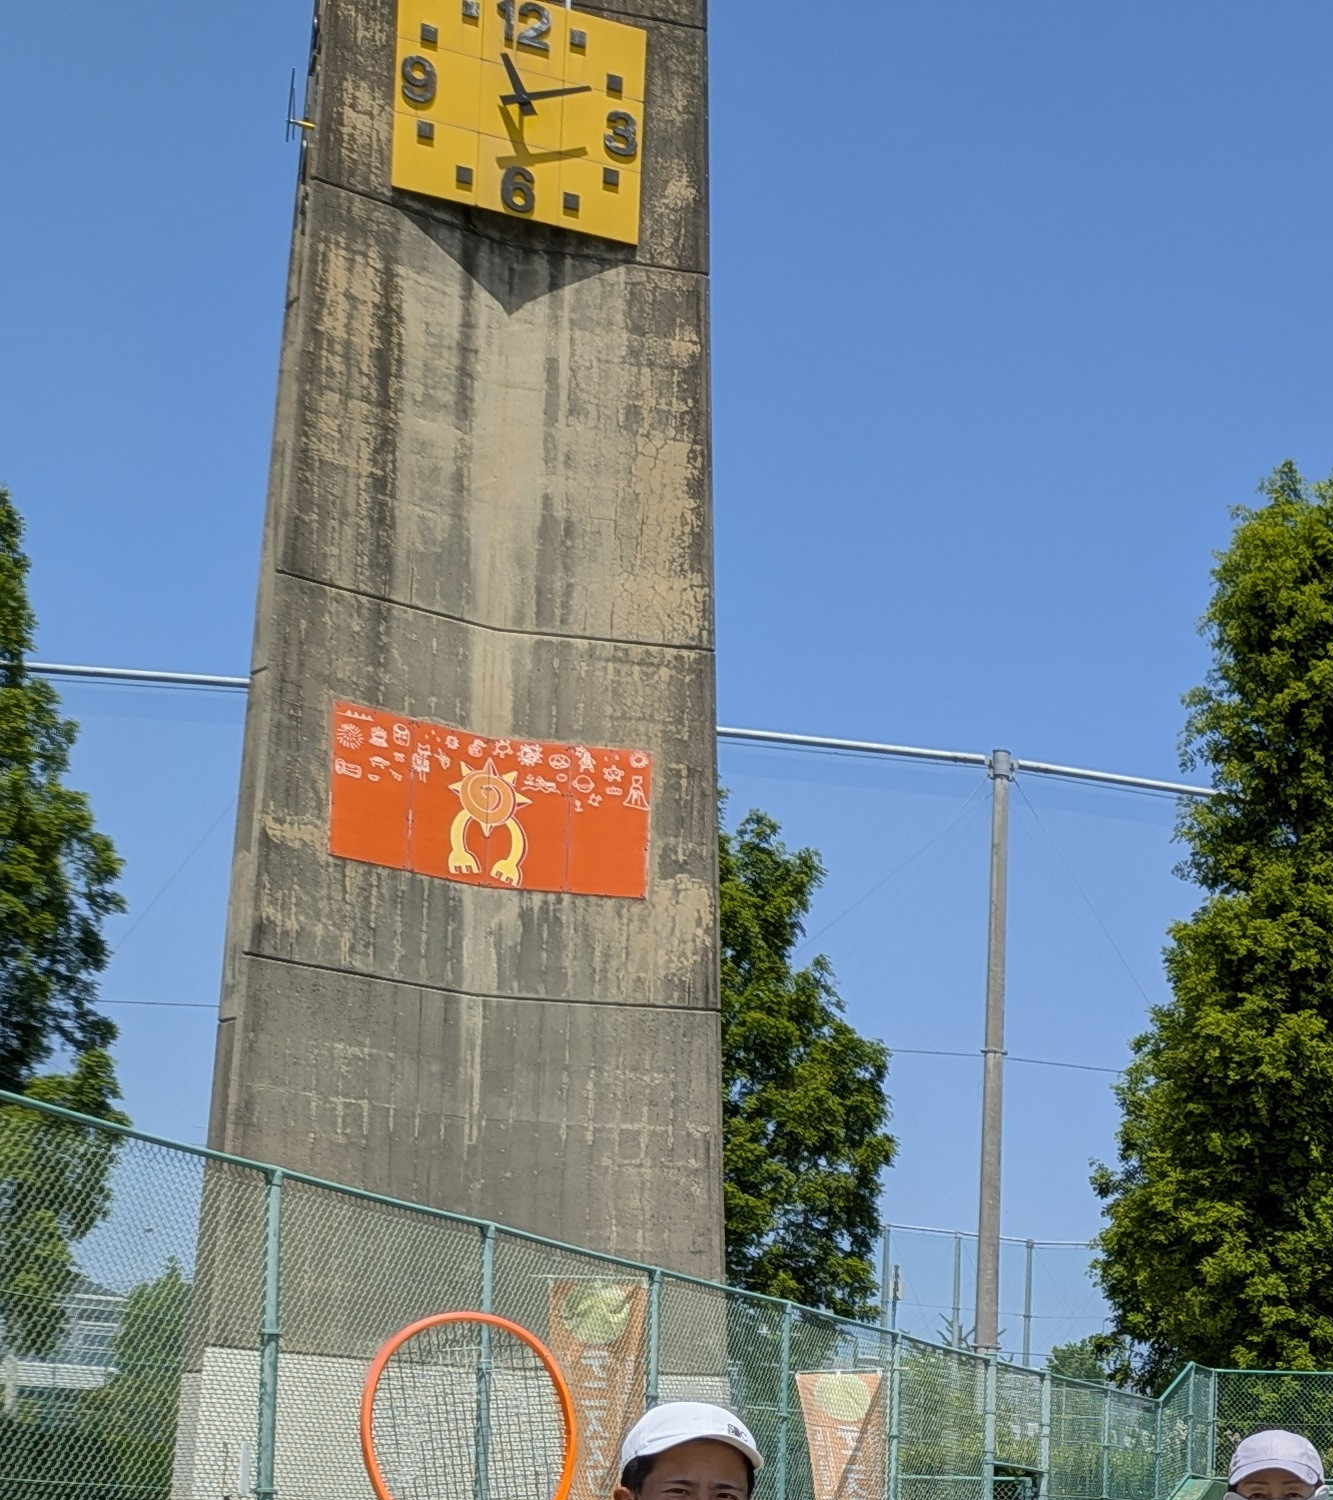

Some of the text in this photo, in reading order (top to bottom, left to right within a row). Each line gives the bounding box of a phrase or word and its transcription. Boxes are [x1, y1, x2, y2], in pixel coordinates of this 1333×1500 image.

[497, 1, 552, 50] 12
[401, 55, 437, 102] 9
[604, 110, 637, 156] 3
[501, 166, 535, 212] 6
